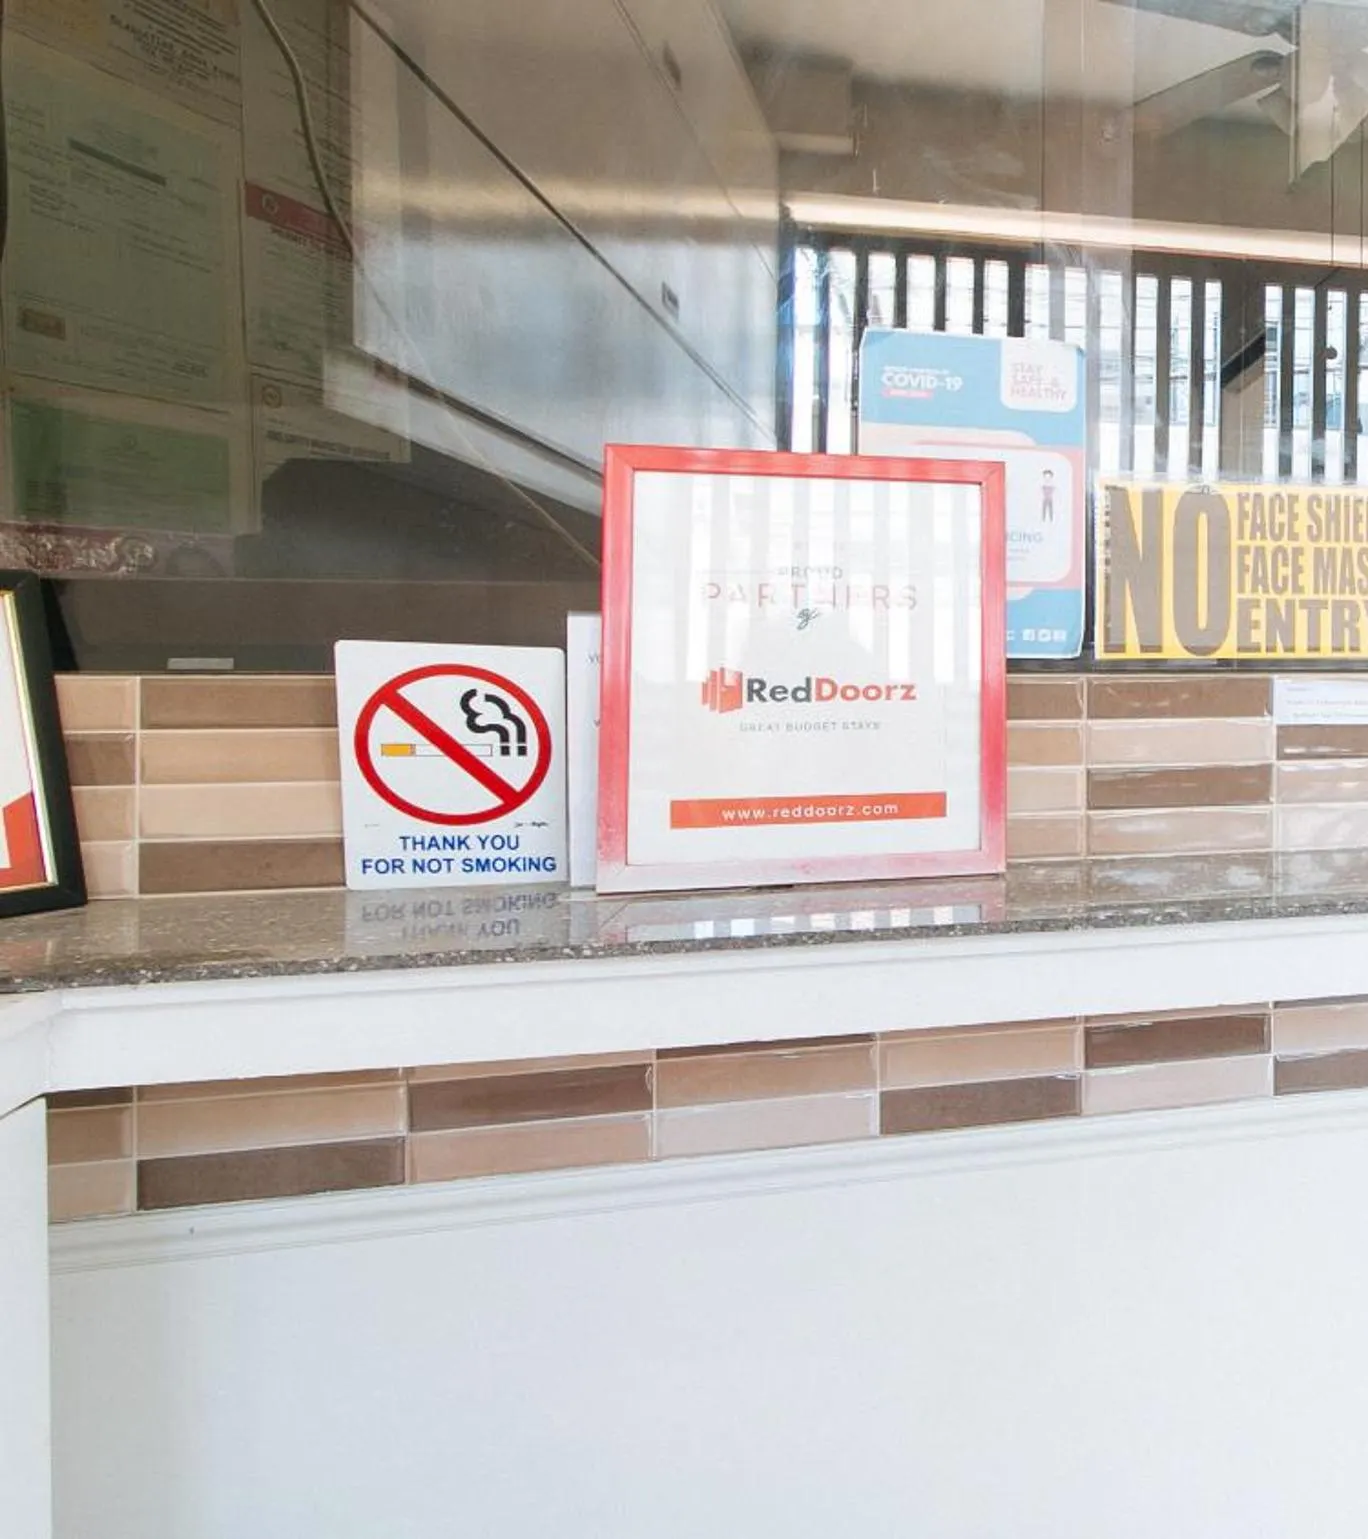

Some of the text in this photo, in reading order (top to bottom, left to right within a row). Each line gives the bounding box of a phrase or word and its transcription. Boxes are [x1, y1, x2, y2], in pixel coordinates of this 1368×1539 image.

[881, 371, 963, 392] COVID-19
[1237, 492, 1300, 541] FACE
[1005, 531, 1044, 544] CING
[777, 565, 844, 580] PROD
[1103, 485, 1232, 655] NO
[1237, 546, 1305, 595] FACE
[746, 675, 918, 703] RedDoorz
[740, 720, 881, 733] GREAT BUDGET STAYS
[720, 802, 900, 821] www.reddoorz.com
[399, 834, 521, 852] THANK YOU
[361, 856, 557, 875] FOR NOT SMOKING
